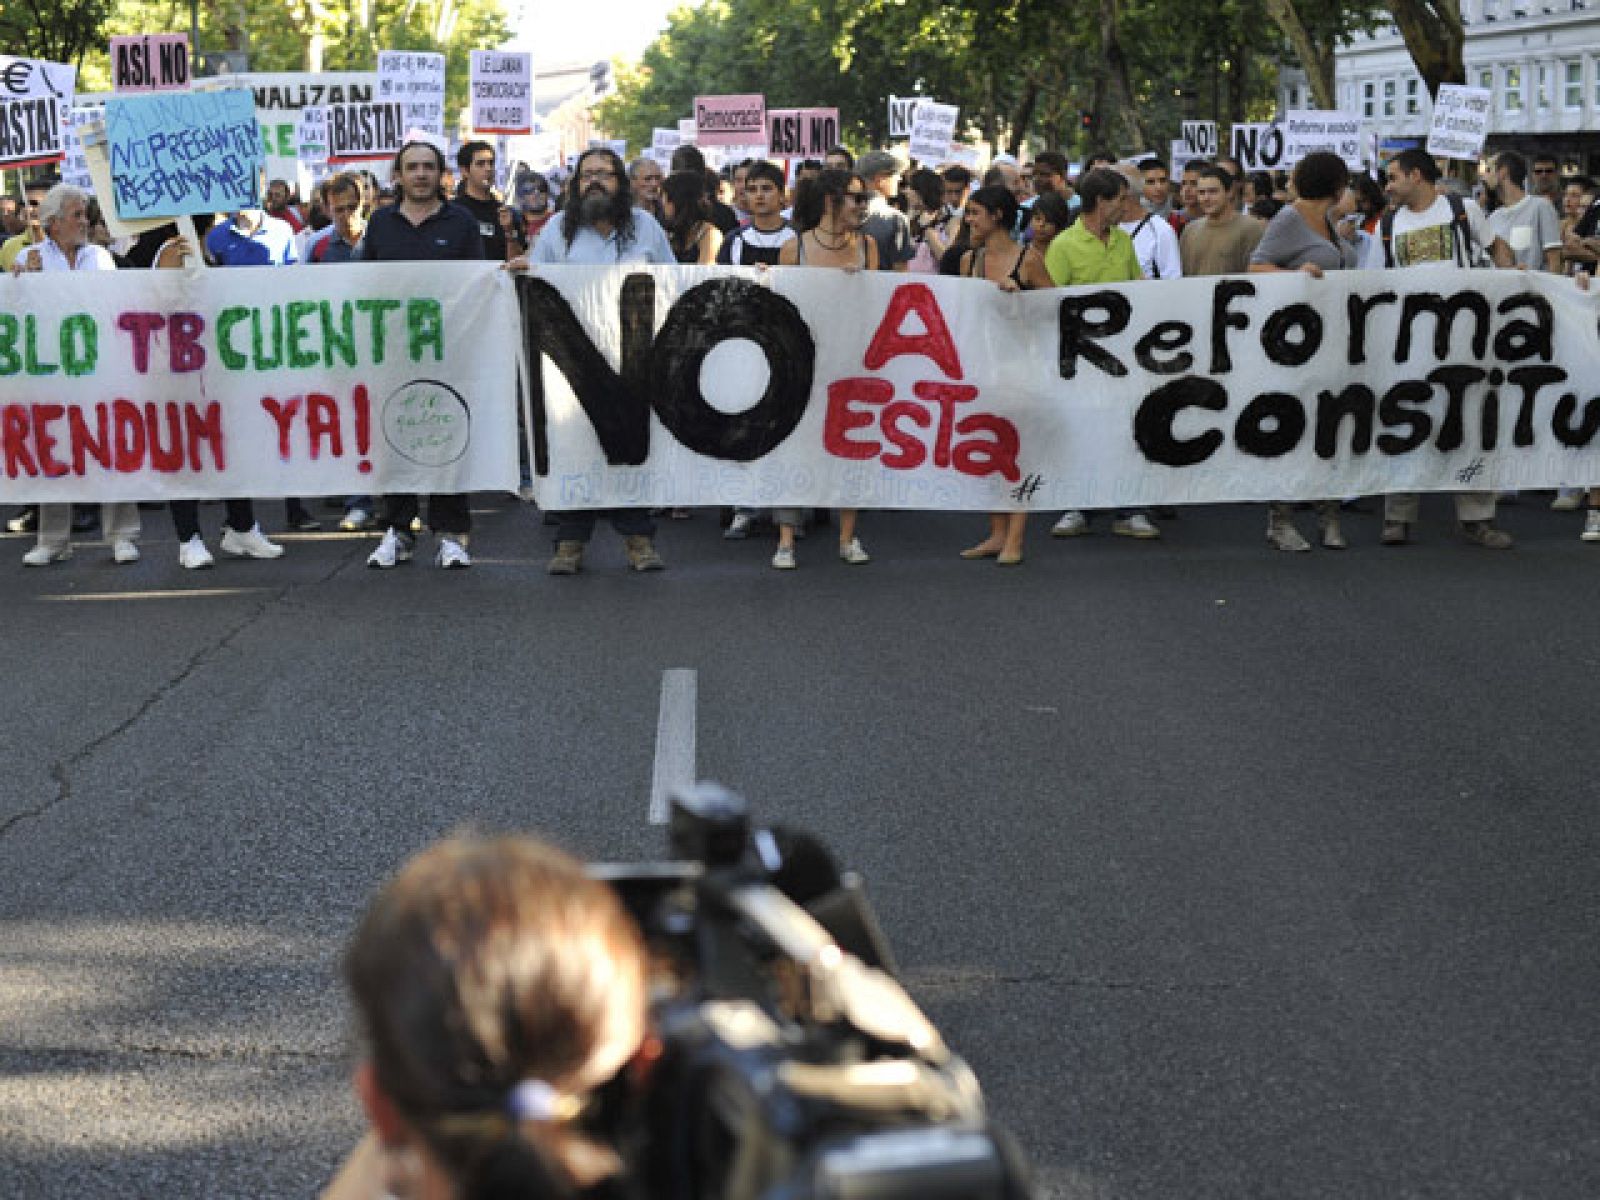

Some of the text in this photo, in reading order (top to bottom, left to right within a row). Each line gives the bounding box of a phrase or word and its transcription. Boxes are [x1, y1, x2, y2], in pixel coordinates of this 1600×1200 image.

[159, 42, 187, 85] NO
[809, 116, 836, 152] NO
[1184, 124, 1215, 154] NO!
[116, 312, 207, 373] TB
[216, 298, 445, 371] CUENTA
[863, 283, 964, 380] A
[1058, 279, 1554, 379] Reforma
[516, 273, 816, 476] NO
[260, 384, 373, 474] YA!
